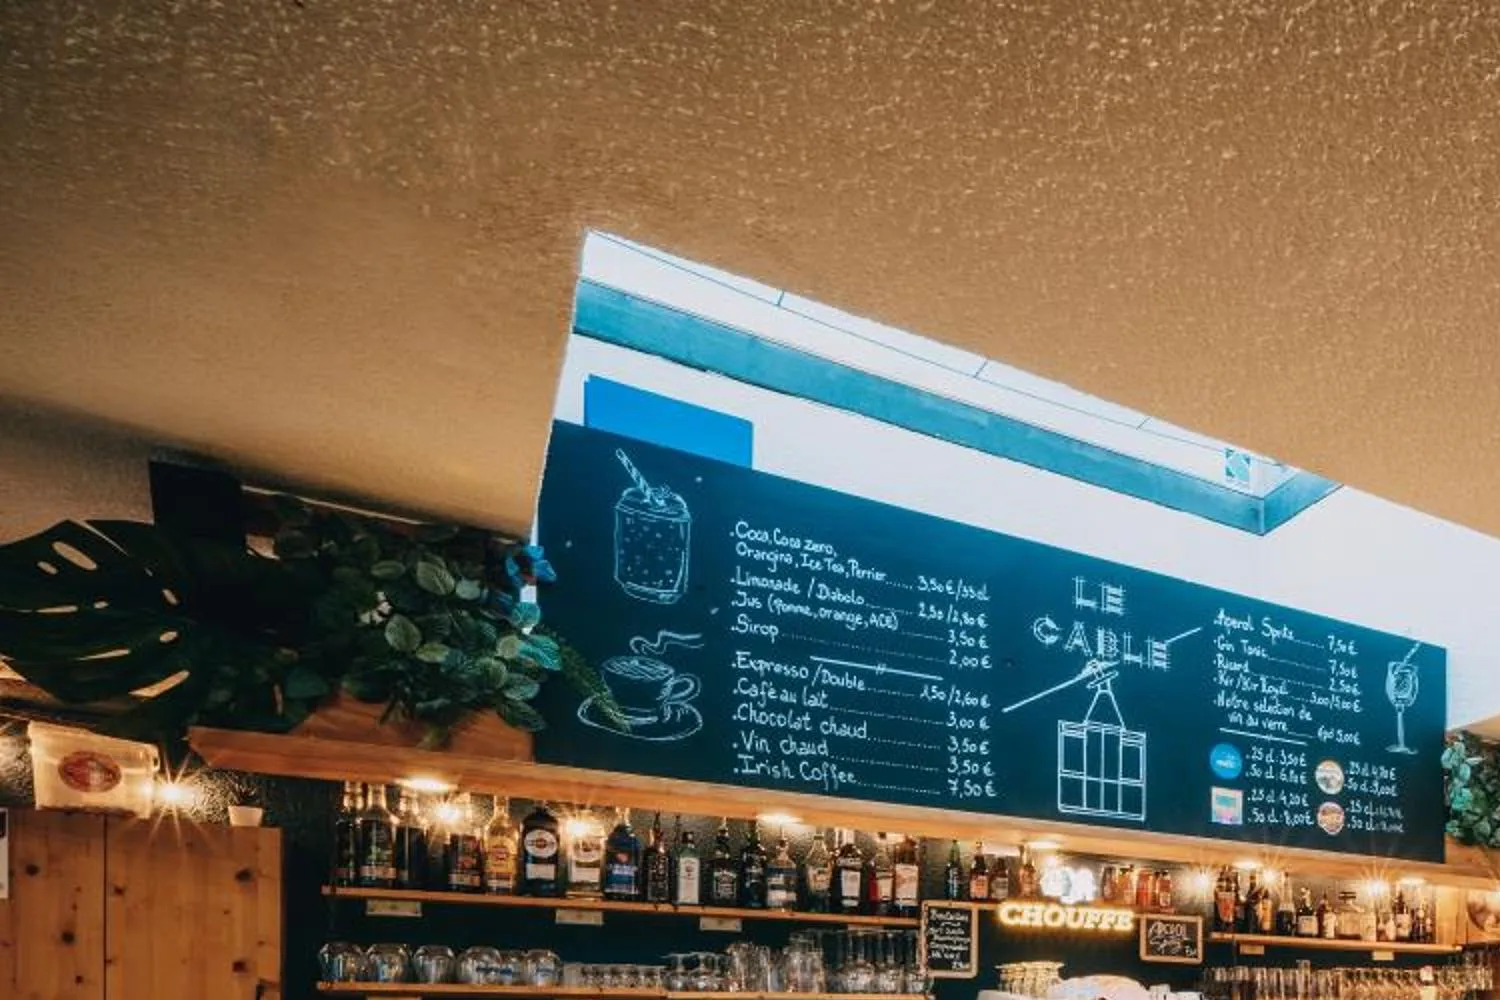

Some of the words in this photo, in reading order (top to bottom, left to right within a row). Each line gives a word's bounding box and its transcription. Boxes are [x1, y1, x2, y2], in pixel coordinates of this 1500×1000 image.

[736, 566, 800, 594] Limonade
[801, 553, 823, 571] Ice
[848, 558, 886, 581] Perrier
[736, 590, 762, 609] Jus
[1073, 575, 1126, 616] LE
[737, 614, 778, 643] Sirop
[1031, 614, 1170, 671] CABLE
[1217, 634, 1234, 652] Gin
[1240, 639, 1268, 658] Tonic
[736, 651, 808, 678] Expresso
[780, 689, 797, 703] au
[802, 686, 828, 709] lait
[737, 702, 812, 731] Chocolat
[820, 715, 867, 739] chaud
[741, 729, 771, 754] Vin
[780, 734, 828, 756] chaud
[737, 754, 795, 779] Irish
[800, 761, 857, 791] Coffee
[1000, 901, 1135, 931] CHOUFFE
